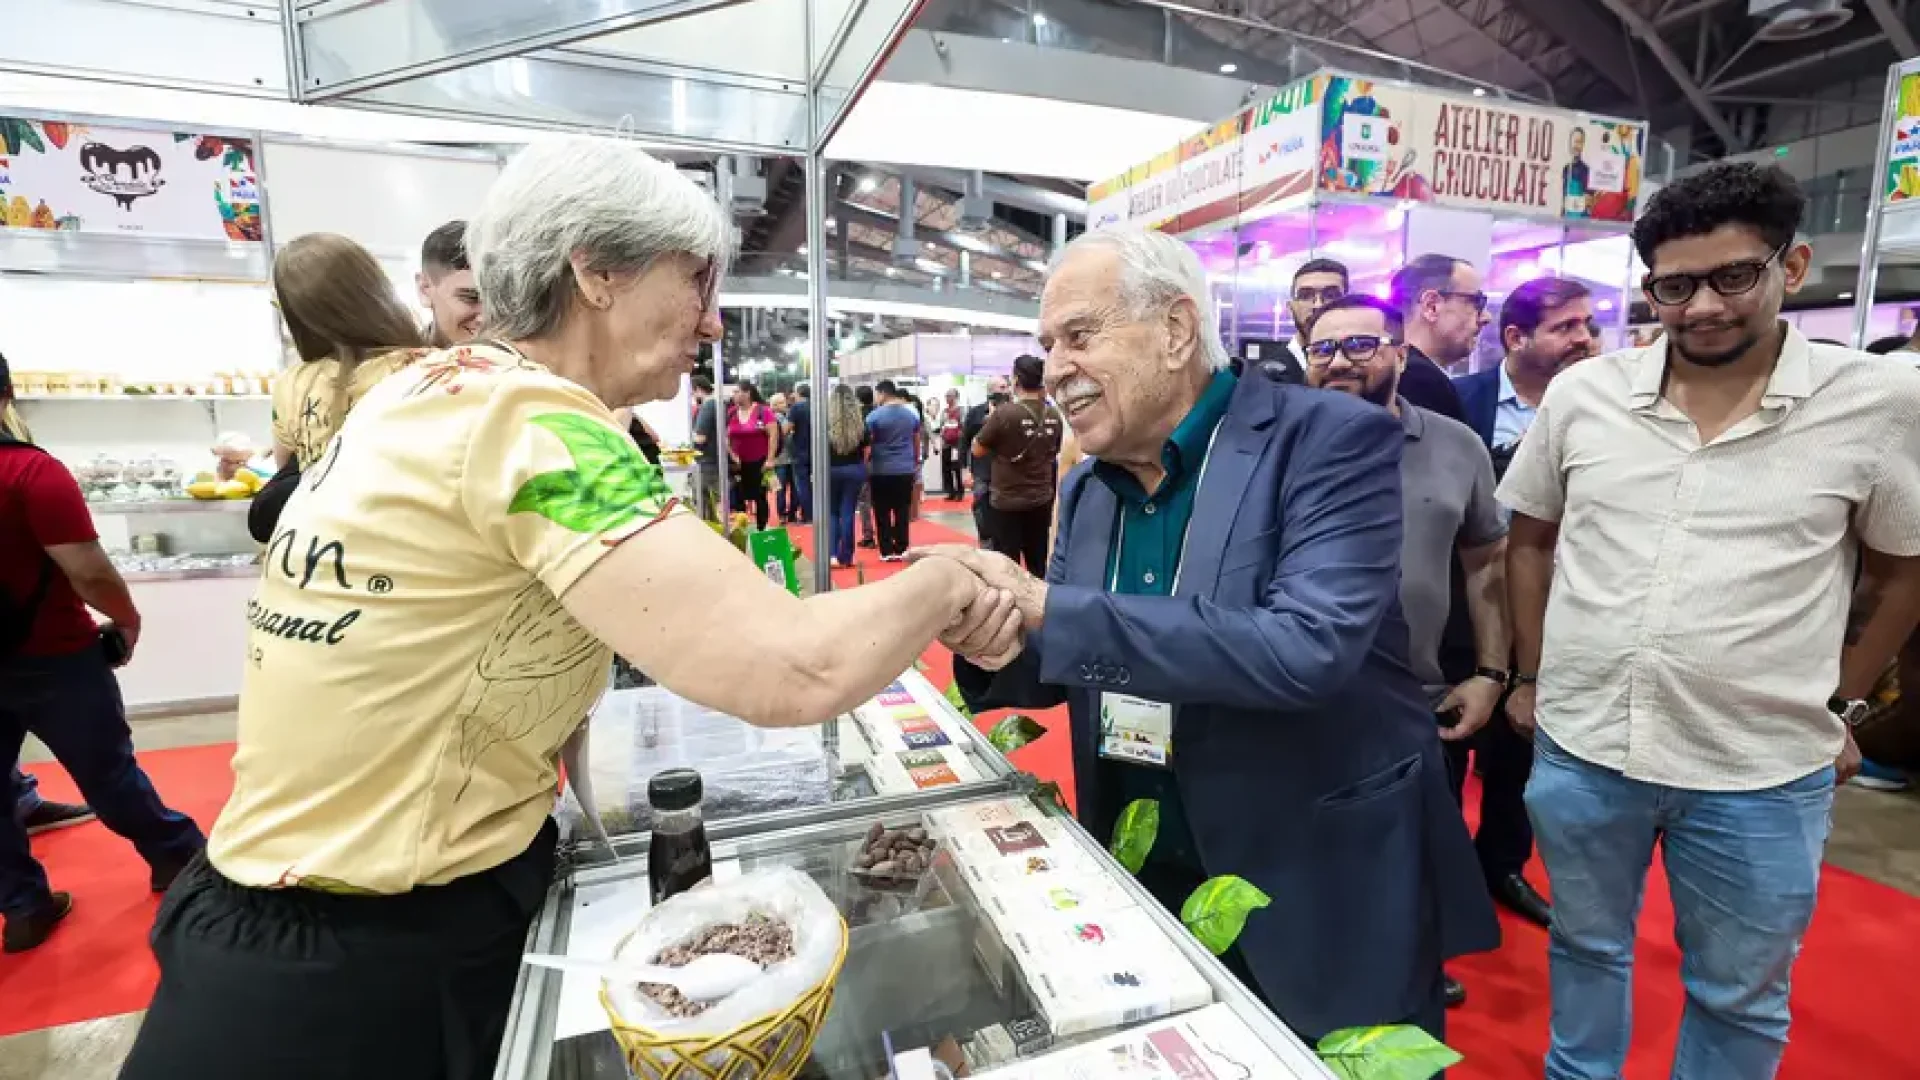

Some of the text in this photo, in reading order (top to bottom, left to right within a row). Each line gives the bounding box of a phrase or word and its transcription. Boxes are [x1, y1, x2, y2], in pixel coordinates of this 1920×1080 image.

[1434, 102, 1554, 161] ATELIER DO
[1432, 149, 1550, 206] CHOCOLATE
